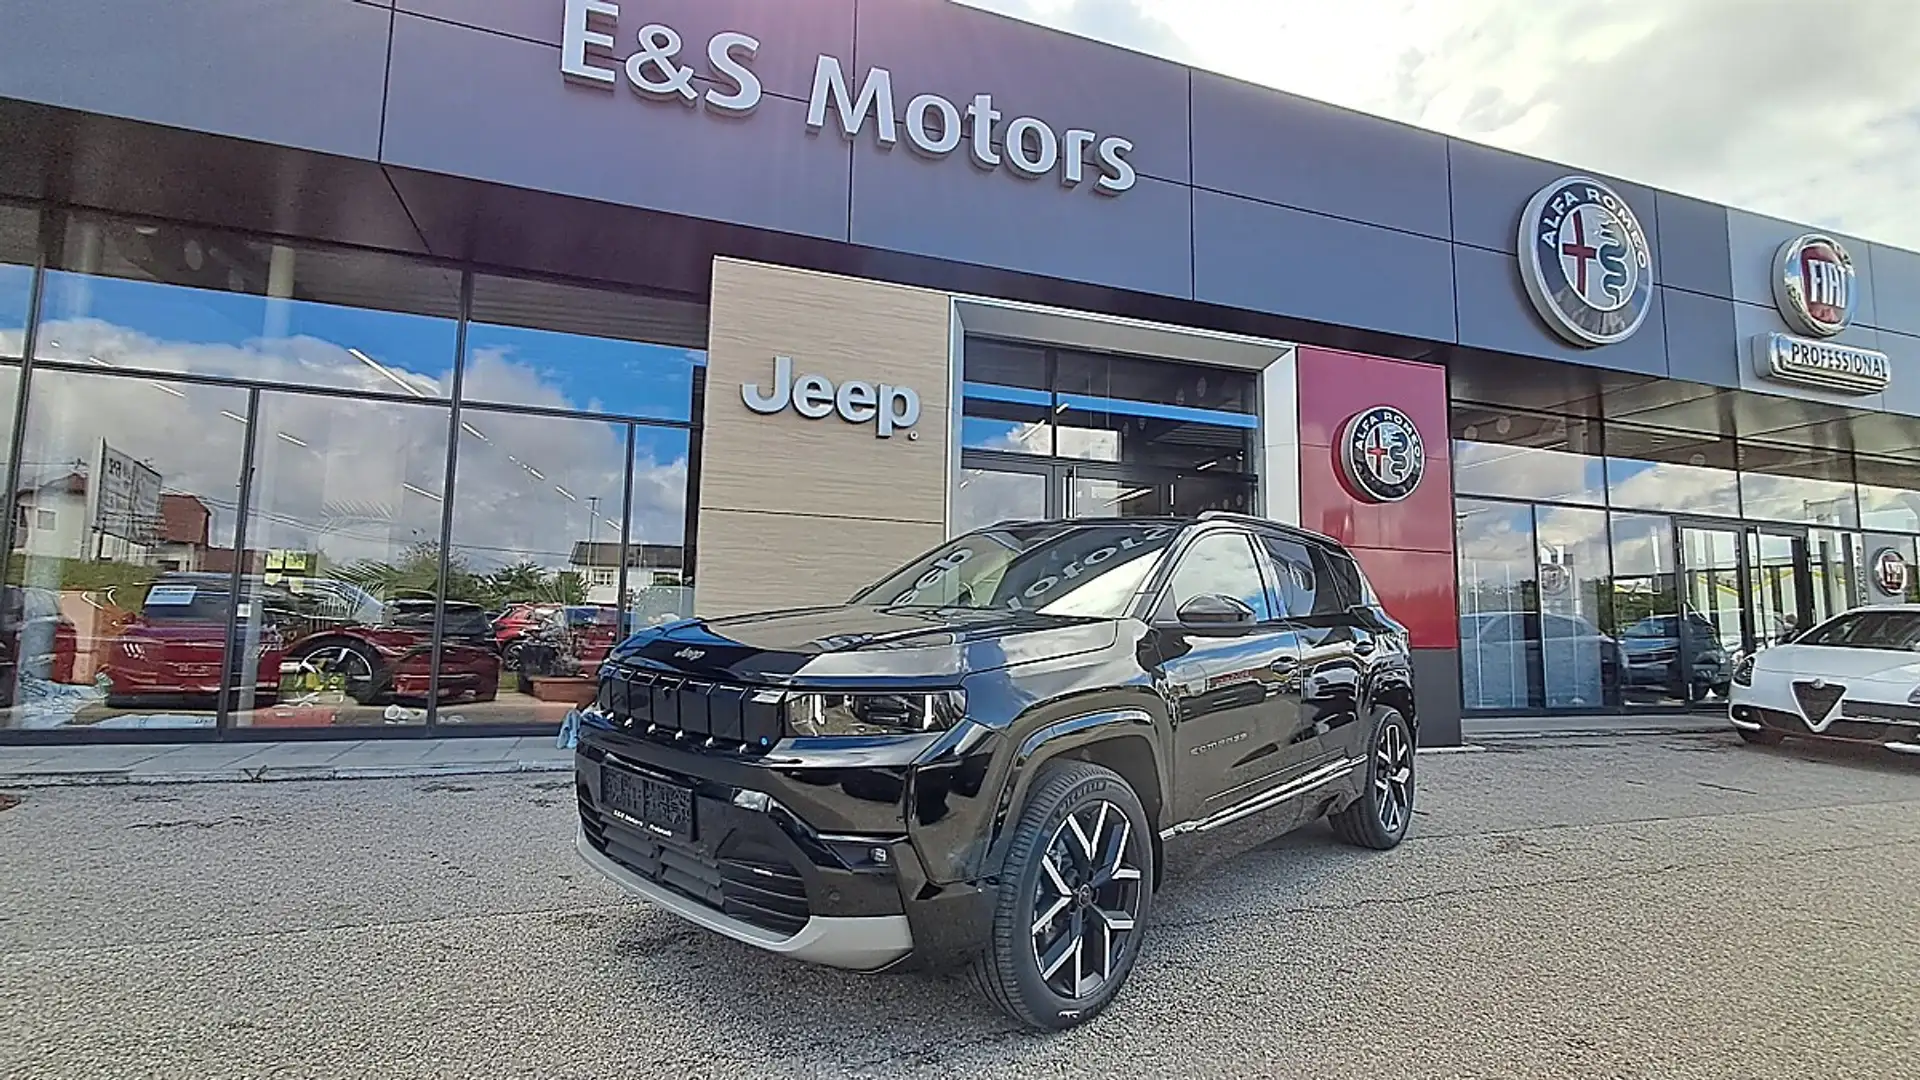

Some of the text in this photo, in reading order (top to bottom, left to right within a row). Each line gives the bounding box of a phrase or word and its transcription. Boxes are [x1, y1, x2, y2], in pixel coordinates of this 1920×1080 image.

[561, 0, 1137, 195] E&S Motors
[1541, 187, 1647, 269] ALFA ROMEO
[1807, 259, 1847, 309] FIAT
[1791, 343, 1888, 378] PROFESSIONAL
[740, 355, 920, 439] Jeep
[1355, 411, 1421, 457] ALFA ROMEO
